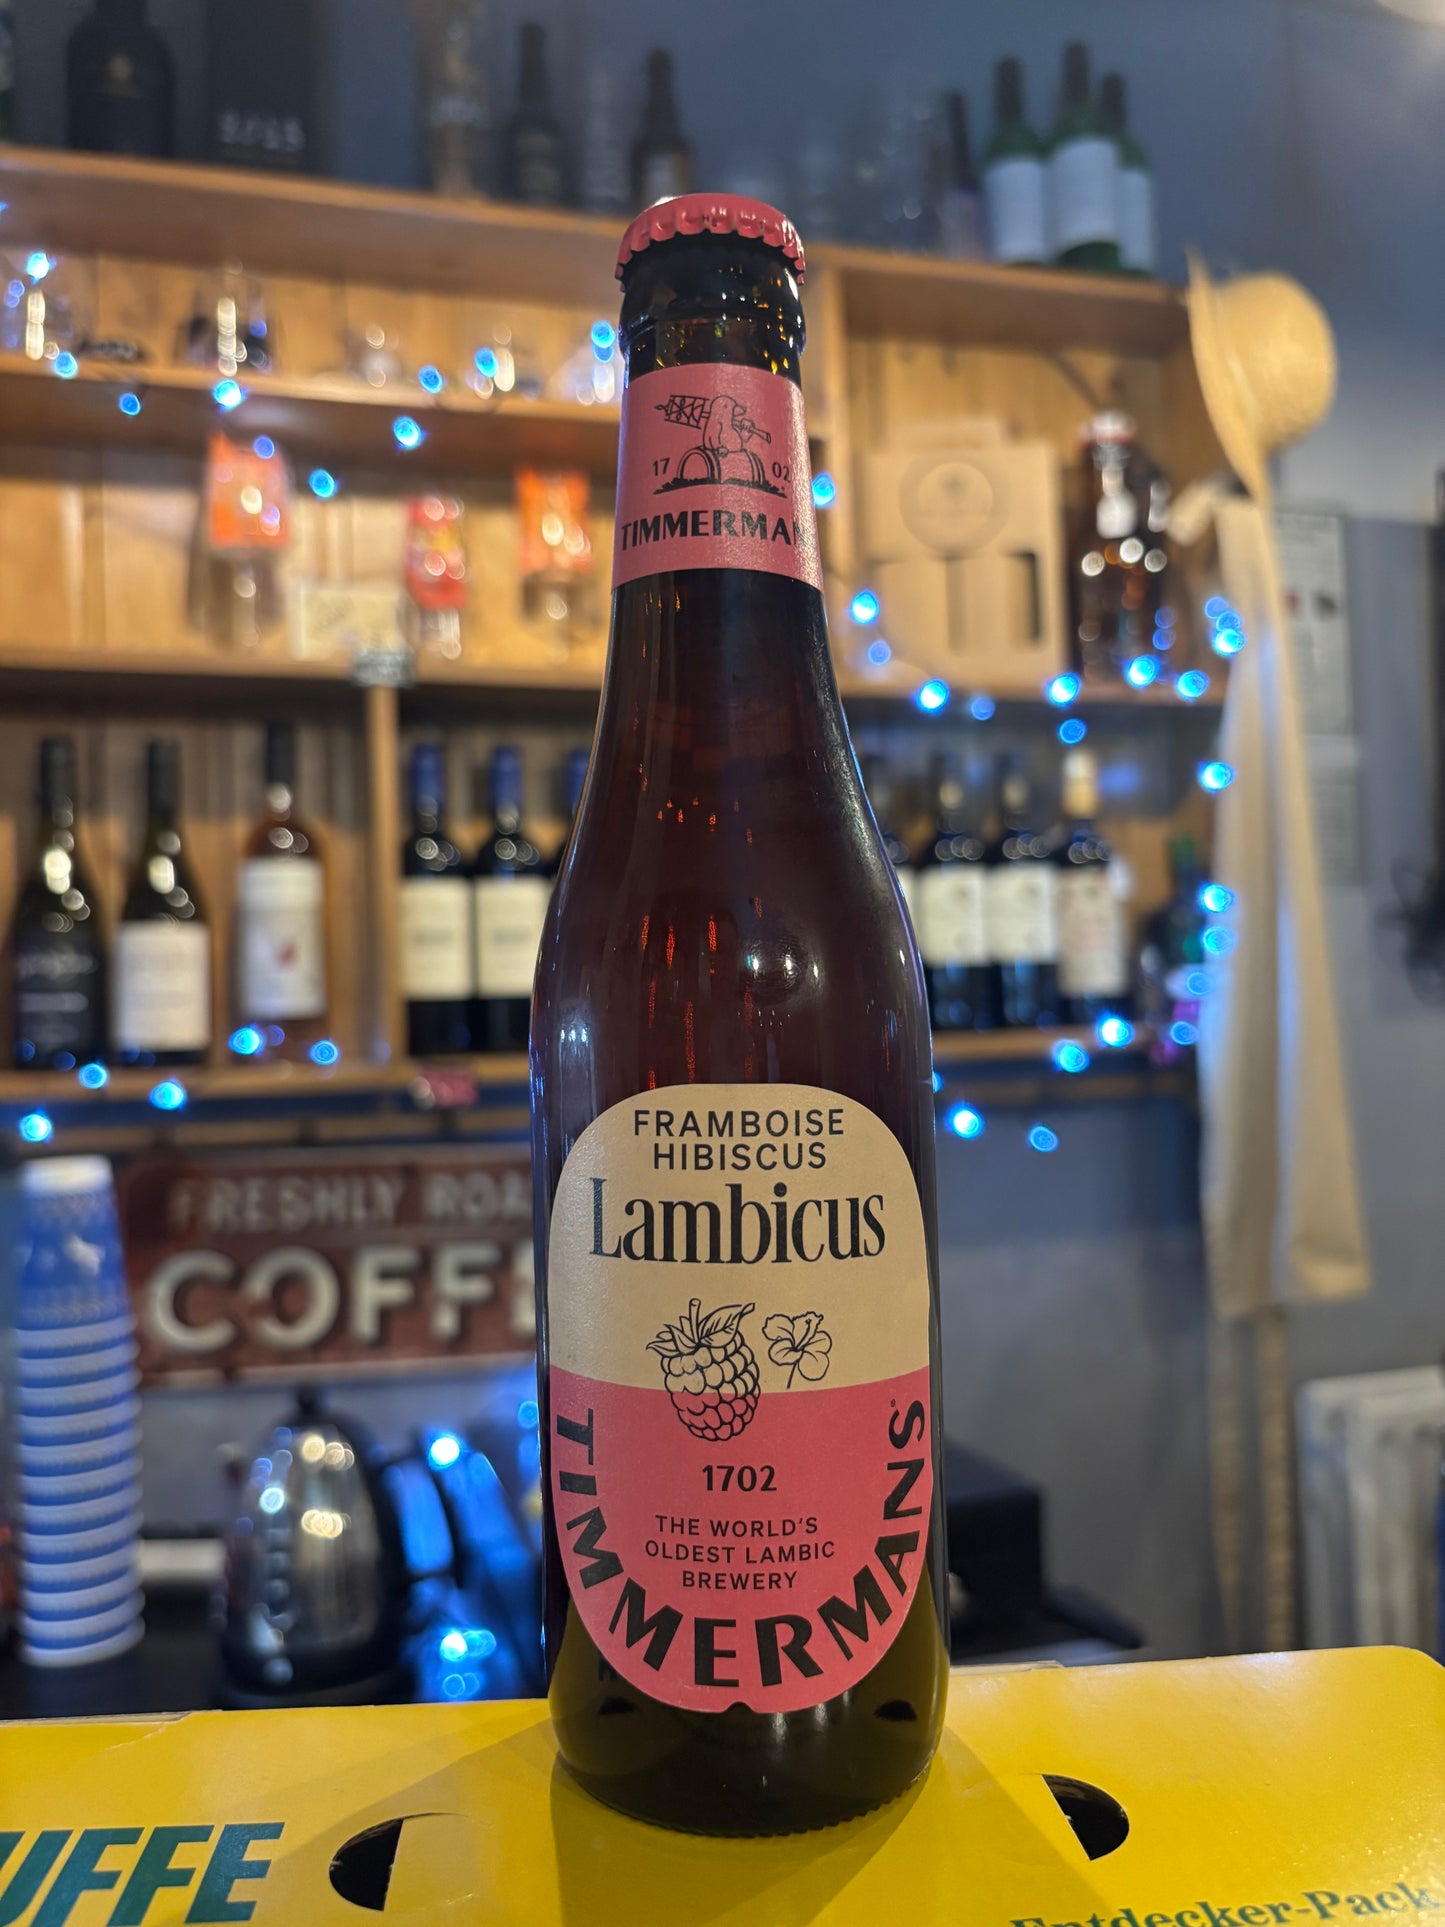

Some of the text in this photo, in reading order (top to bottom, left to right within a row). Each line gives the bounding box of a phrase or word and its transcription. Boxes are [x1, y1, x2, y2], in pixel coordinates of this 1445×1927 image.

[652, 457, 792, 484] 17 02
[633, 1108, 844, 1138] FRAMBOISE
[653, 1141, 827, 1171] HIBISCUS
[169, 1174, 405, 1232] FRESHLY
[589, 1176, 885, 1264] Lambicus
[701, 1464, 778, 1492] 1702
[655, 1514, 819, 1538] THE WORLD'S
[645, 1539, 836, 1564] OLDEST LAMBIC
[682, 1570, 798, 1590] BREWERY
